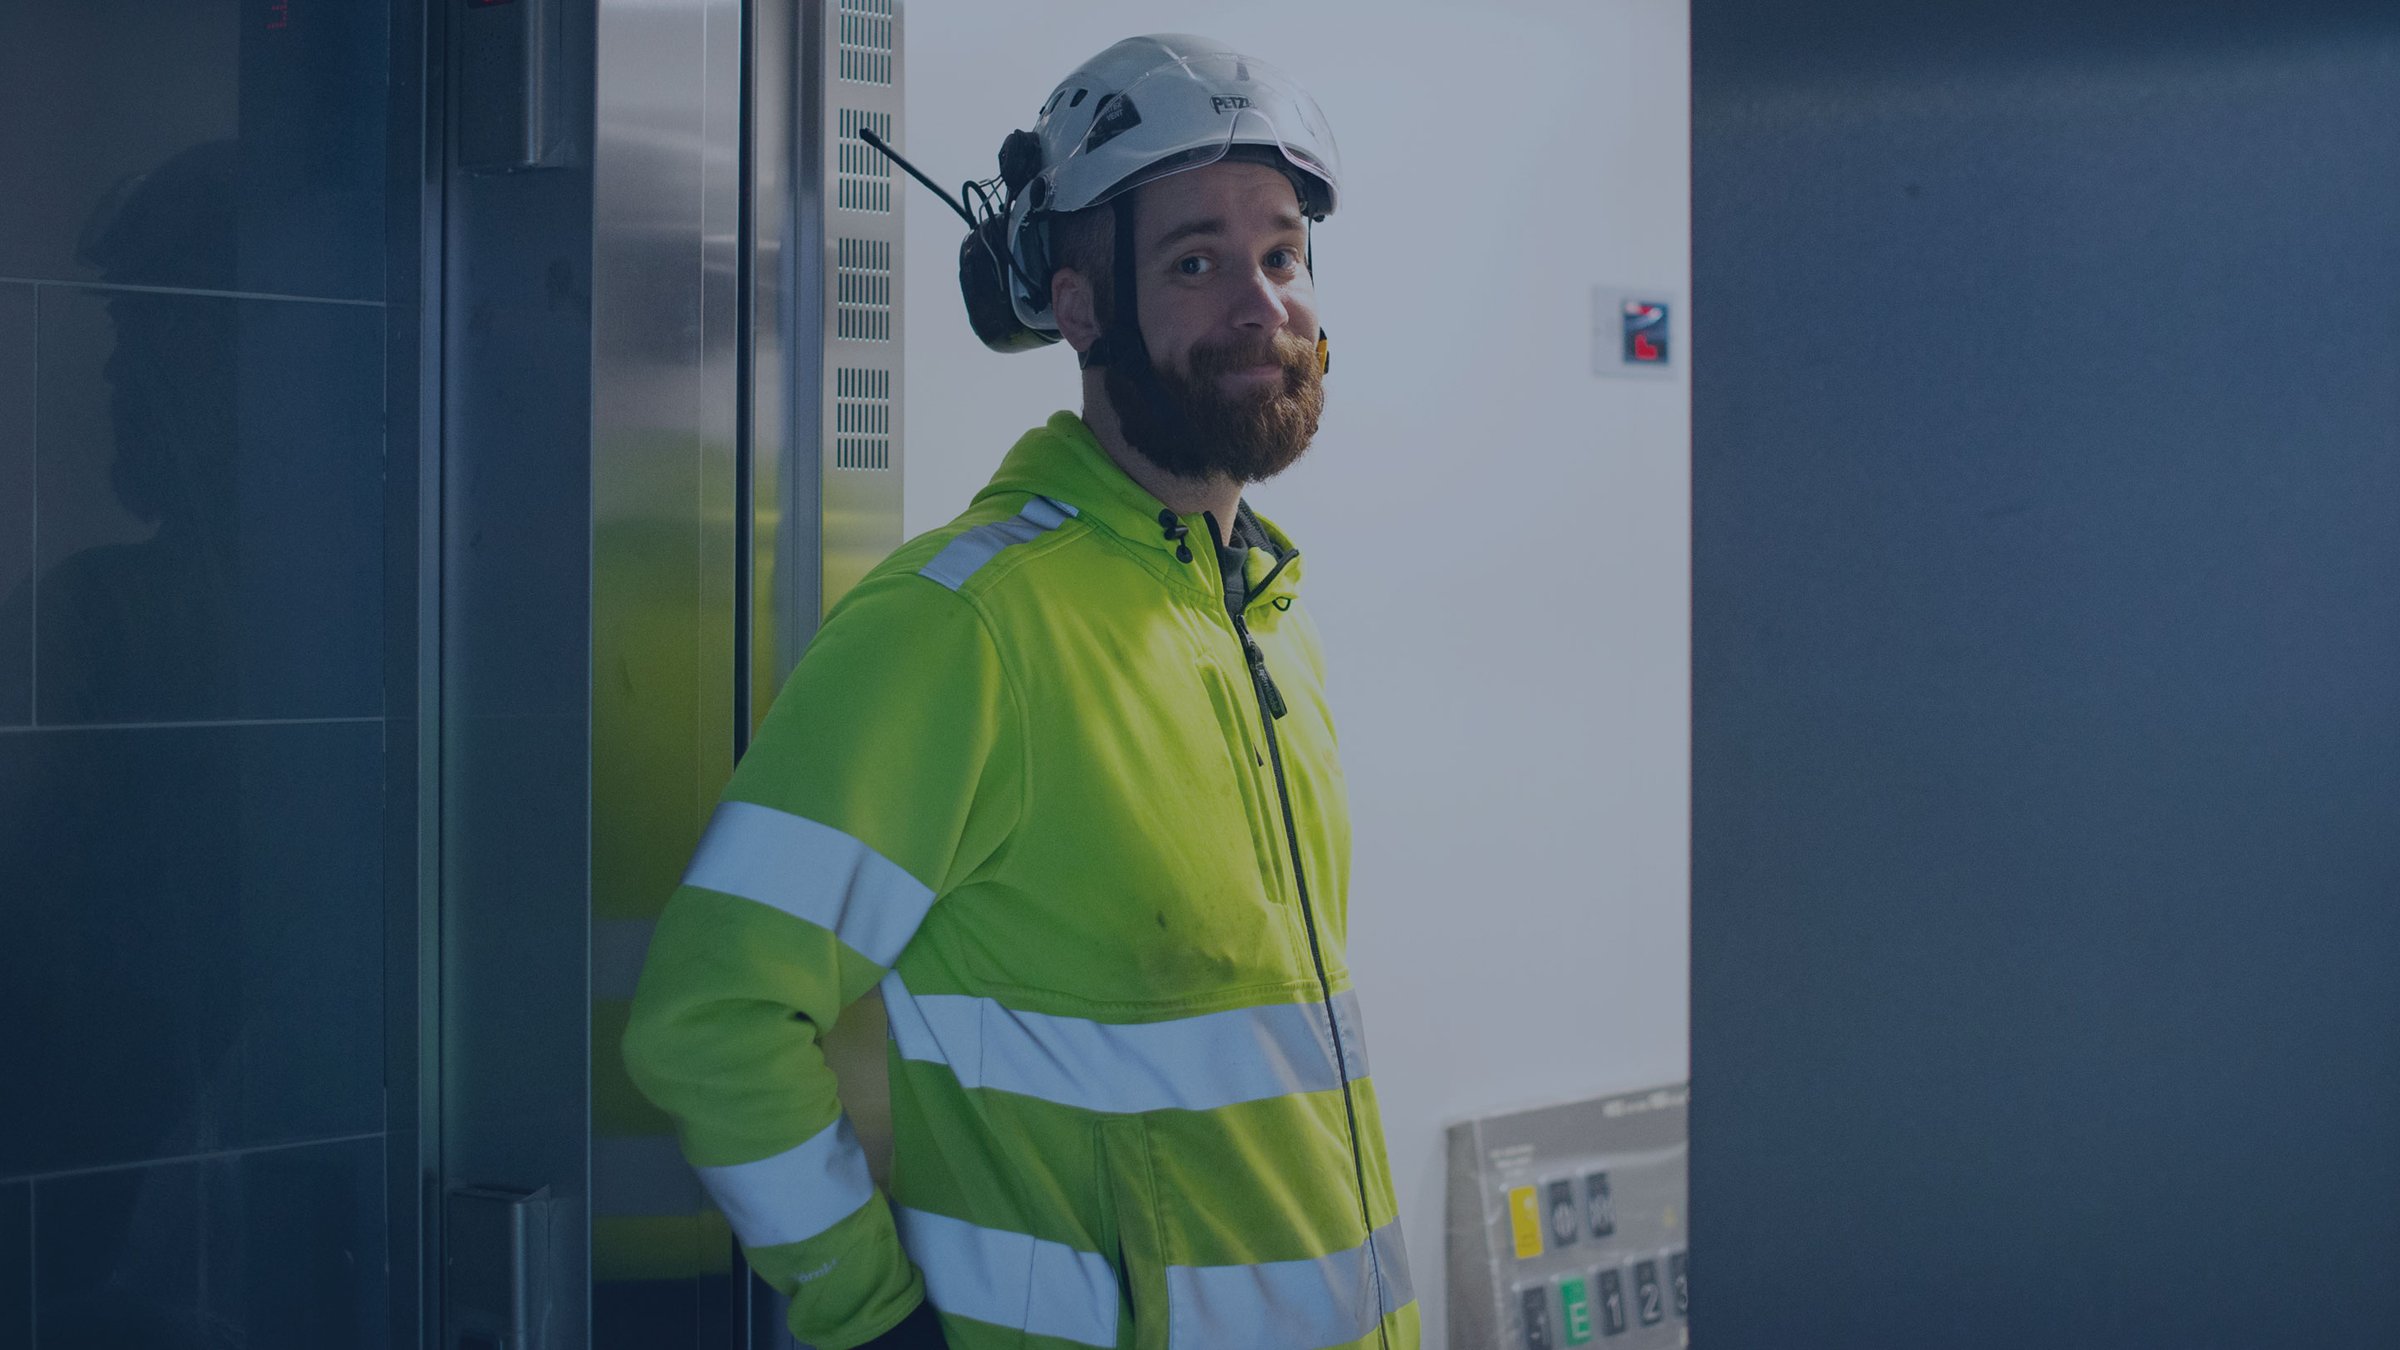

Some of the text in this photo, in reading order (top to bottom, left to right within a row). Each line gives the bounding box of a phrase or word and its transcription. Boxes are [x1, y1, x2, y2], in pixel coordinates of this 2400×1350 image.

[1569, 1302, 1590, 1338] E
[1607, 1294, 1621, 1334] 1
[1641, 1284, 1660, 1321] 2
